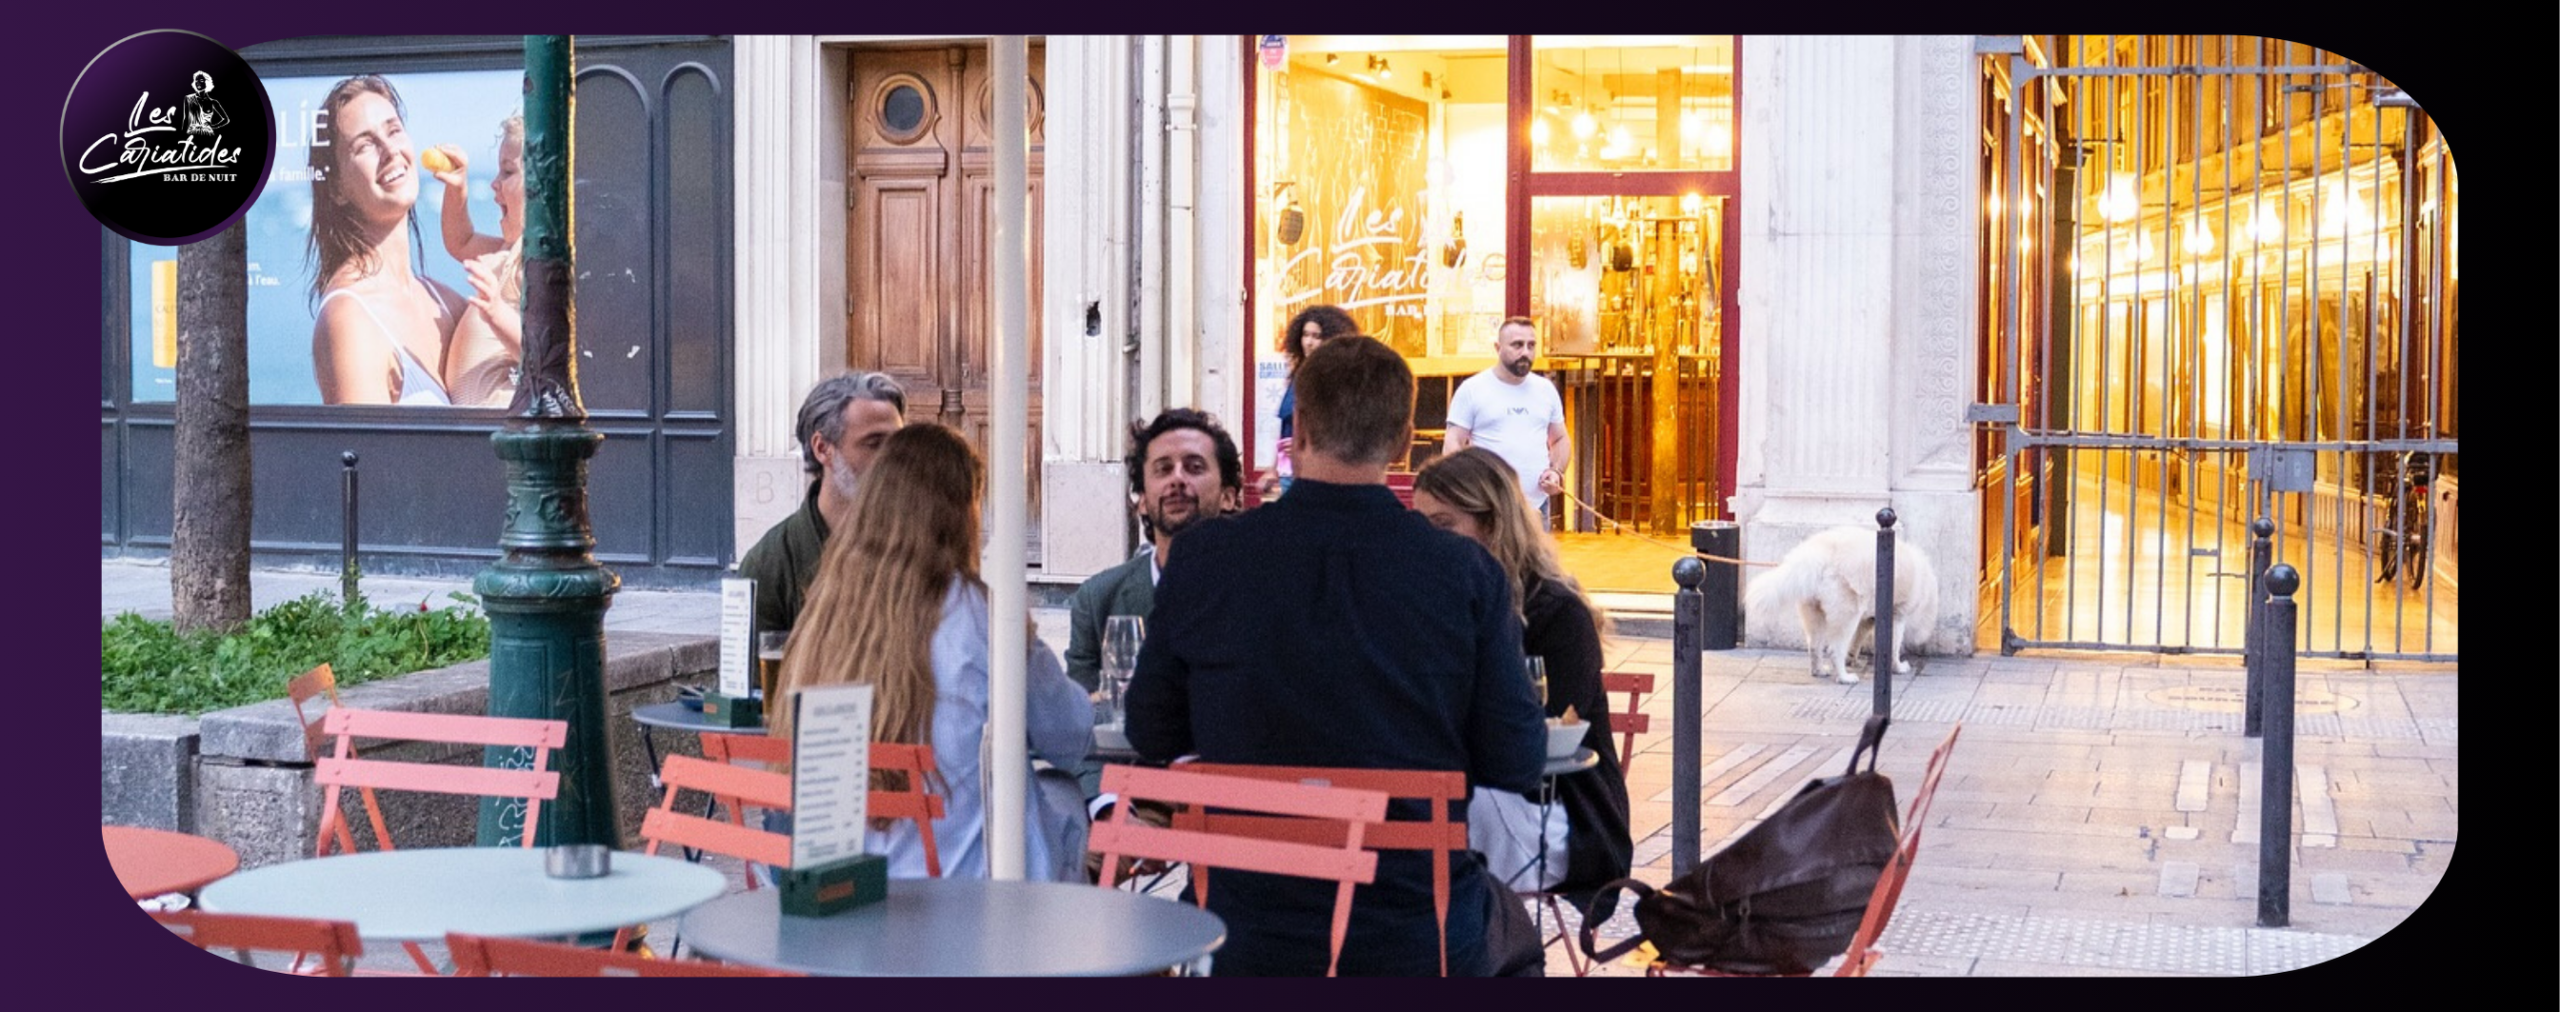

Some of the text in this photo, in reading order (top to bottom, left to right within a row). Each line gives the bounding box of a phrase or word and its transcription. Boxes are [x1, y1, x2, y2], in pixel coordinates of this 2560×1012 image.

[276, 99, 331, 147] LÍE
[1331, 185, 1403, 252] Les
[1275, 246, 1491, 304] Cariatid
